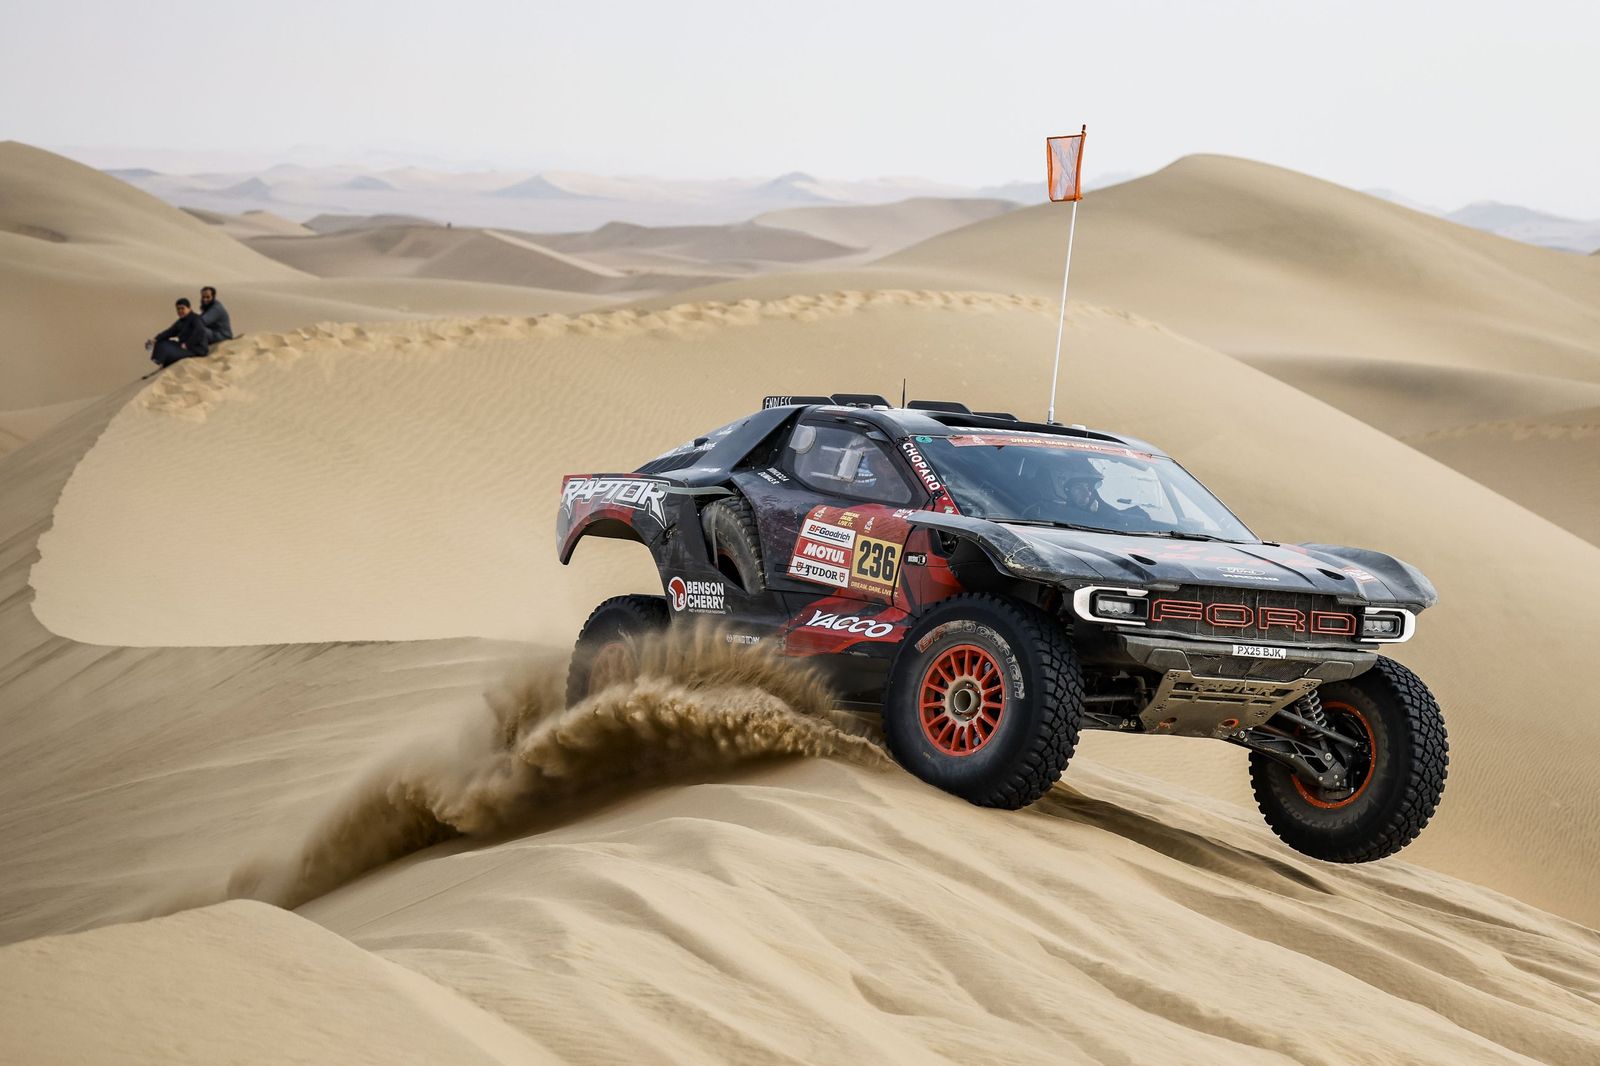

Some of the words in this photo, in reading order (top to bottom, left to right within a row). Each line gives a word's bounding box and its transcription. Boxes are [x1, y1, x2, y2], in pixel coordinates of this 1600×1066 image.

[902, 442, 941, 491] CHOPARD
[560, 478, 671, 529] RAPTOR
[808, 524, 850, 541] BFGoodrich
[803, 542, 845, 565] MOTUL
[857, 539, 896, 582] 236
[805, 565, 838, 581] TUDOR
[686, 581, 725, 596] BENSON
[687, 595, 725, 609] CHERRY
[805, 609, 894, 638] YACCO
[1152, 598, 1357, 636] FORD
[1237, 646, 1261, 656] PX25
[1262, 648, 1281, 658] BJK
